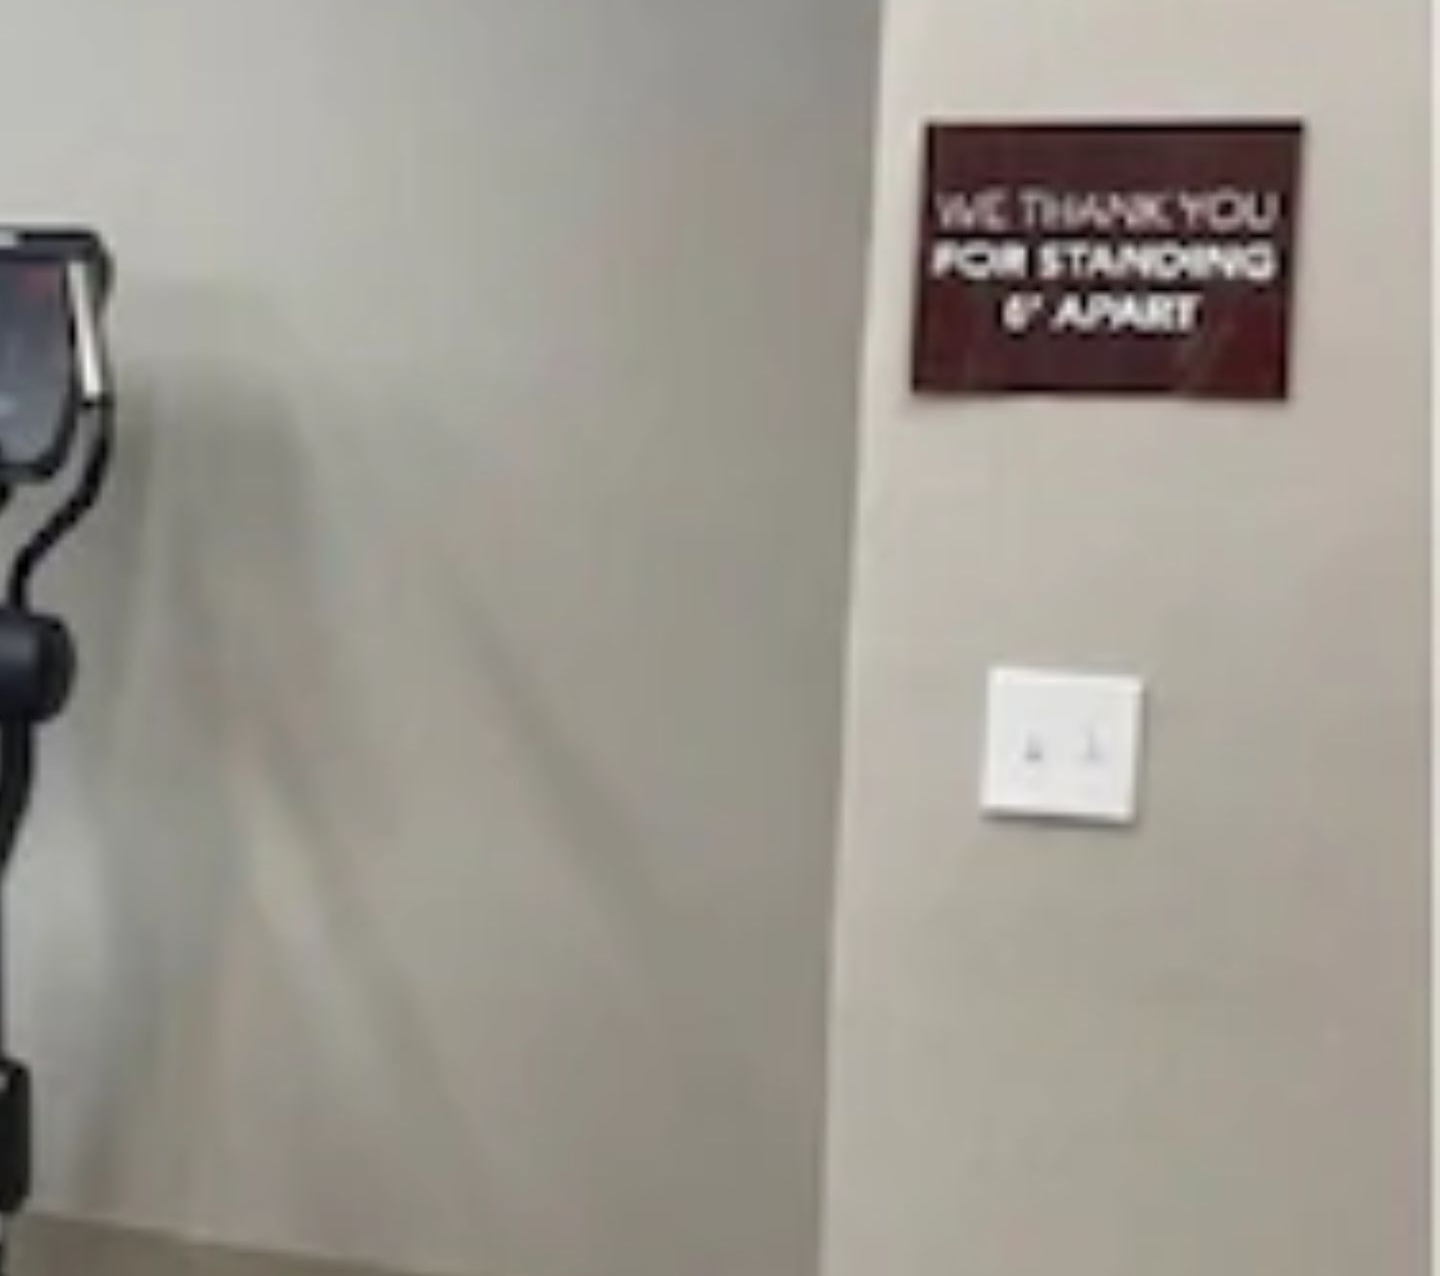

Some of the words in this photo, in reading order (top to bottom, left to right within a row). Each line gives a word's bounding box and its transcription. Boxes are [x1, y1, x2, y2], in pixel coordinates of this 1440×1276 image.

[935, 190, 1007, 231] WE
[1018, 189, 1174, 231] THANK
[1178, 188, 1280, 231] YOU
[932, 239, 1027, 280] FOR
[1038, 239, 1278, 281] STANDING
[1050, 292, 1203, 332] APART
